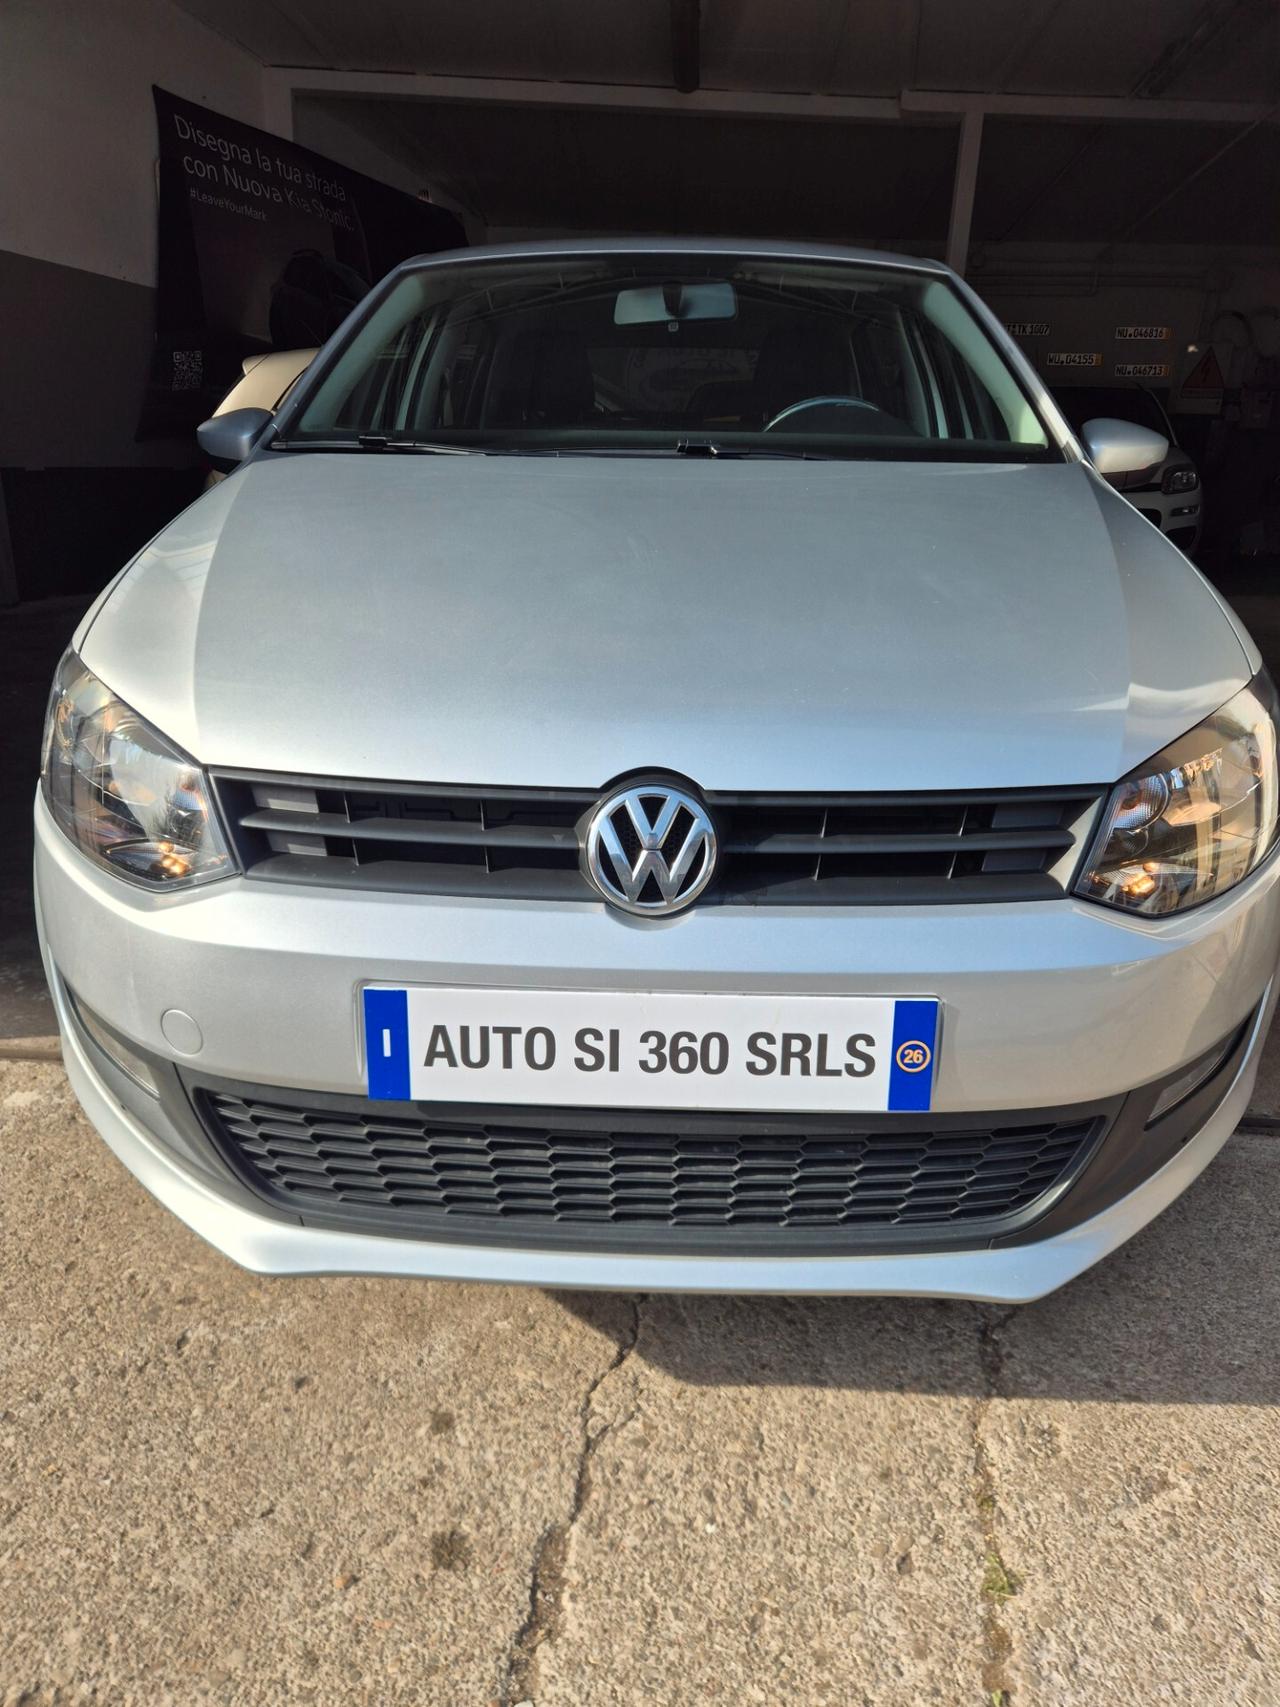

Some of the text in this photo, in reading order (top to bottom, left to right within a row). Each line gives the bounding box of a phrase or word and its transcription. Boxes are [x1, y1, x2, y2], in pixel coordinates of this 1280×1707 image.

[174, 114, 346, 201] Disegna la tua strada
[183, 156, 218, 182] con
[223, 165, 282, 202] Nuova
[284, 187, 312, 214] Kia
[190, 187, 267, 221] #LeaveYourMark
[423, 1025, 876, 1078] AUTO SI 360 SRLS
[903, 1049, 923, 1064] 26
